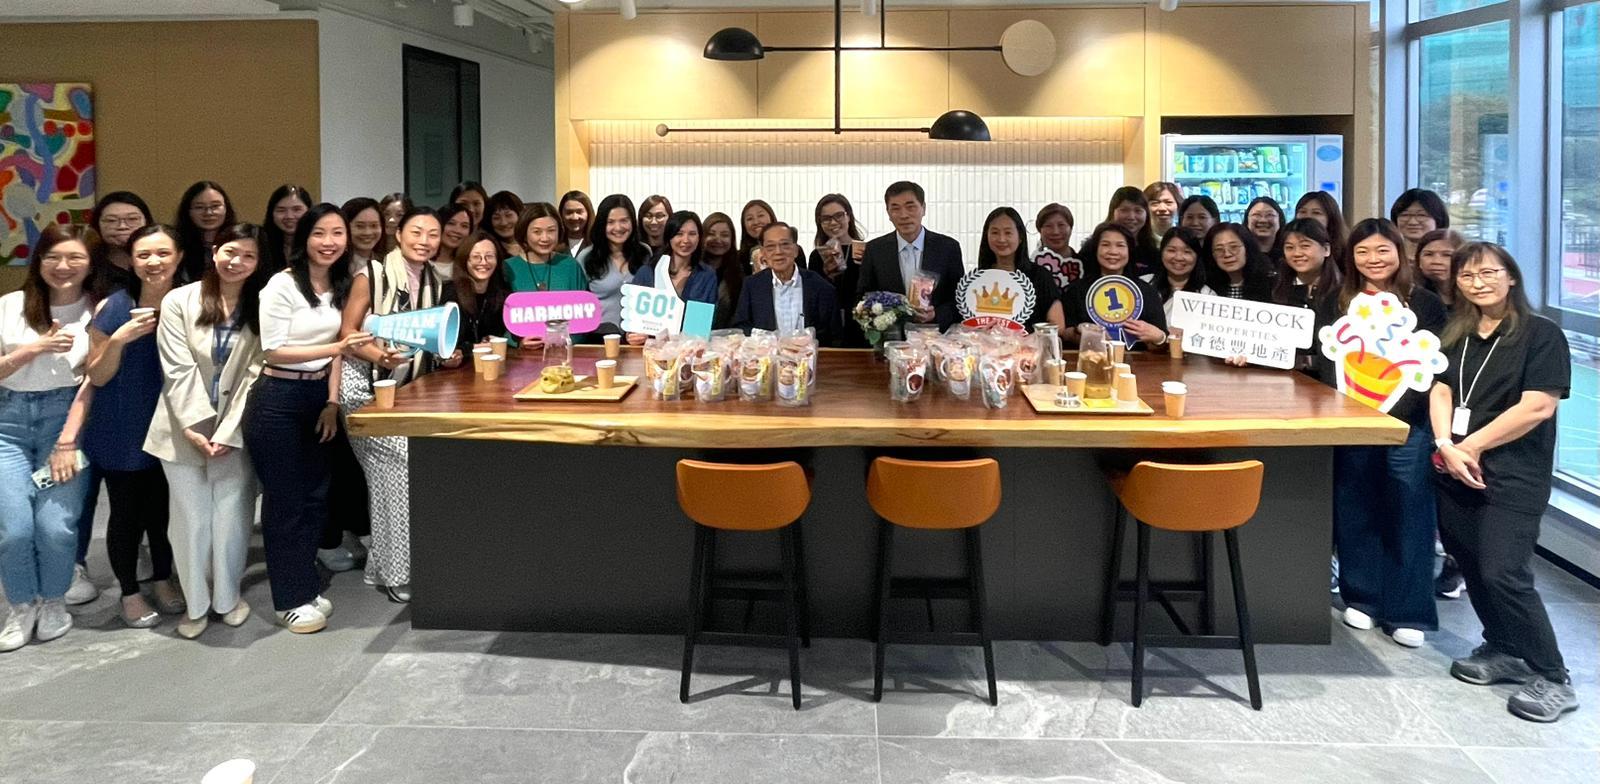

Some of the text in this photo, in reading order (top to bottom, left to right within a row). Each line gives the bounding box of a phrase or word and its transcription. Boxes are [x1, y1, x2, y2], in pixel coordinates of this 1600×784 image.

[635, 291, 676, 319] GO!
[1104, 288, 1124, 311] 1
[510, 303, 596, 324] HARMONY
[975, 317, 990, 326] THE
[1181, 298, 1304, 330] WHEELOCK
[1200, 322, 1279, 341] PROPERTIES
